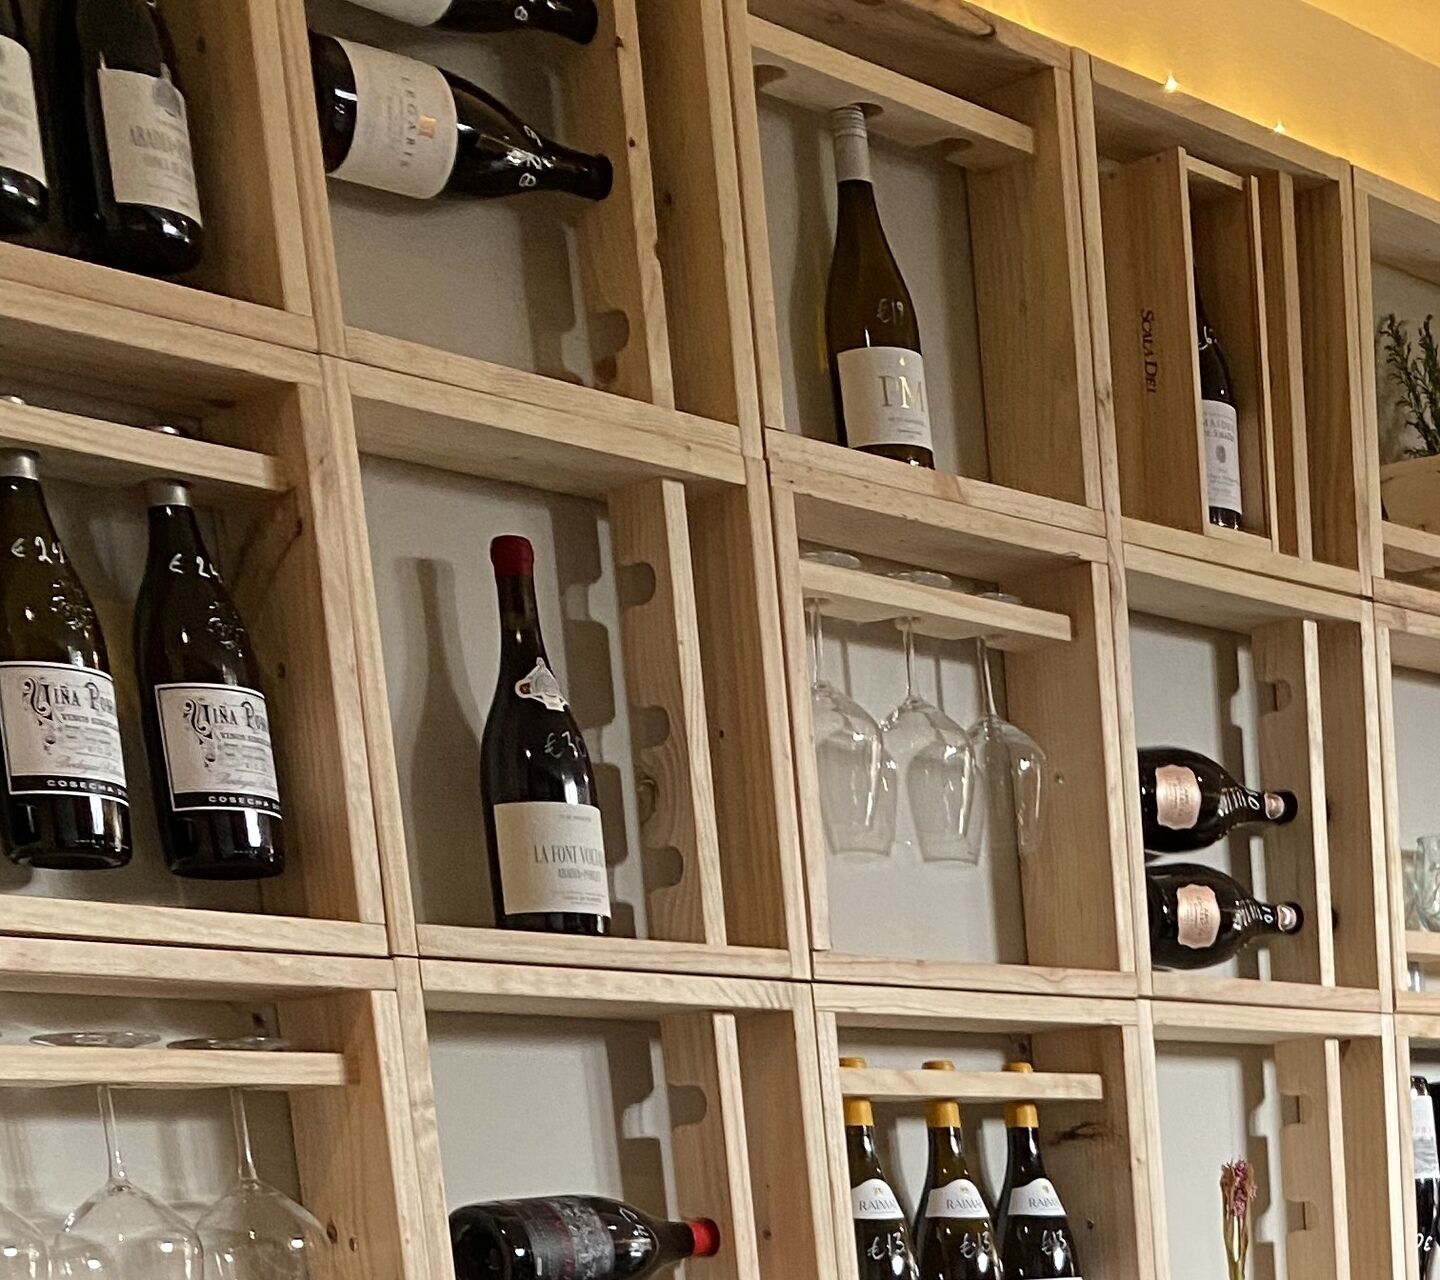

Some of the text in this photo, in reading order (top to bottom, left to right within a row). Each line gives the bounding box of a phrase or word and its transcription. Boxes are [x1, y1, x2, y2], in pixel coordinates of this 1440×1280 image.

[46, 779, 114, 794] COSECHA
[208, 794, 269, 809] COSECHA
[533, 844, 549, 864] LA
